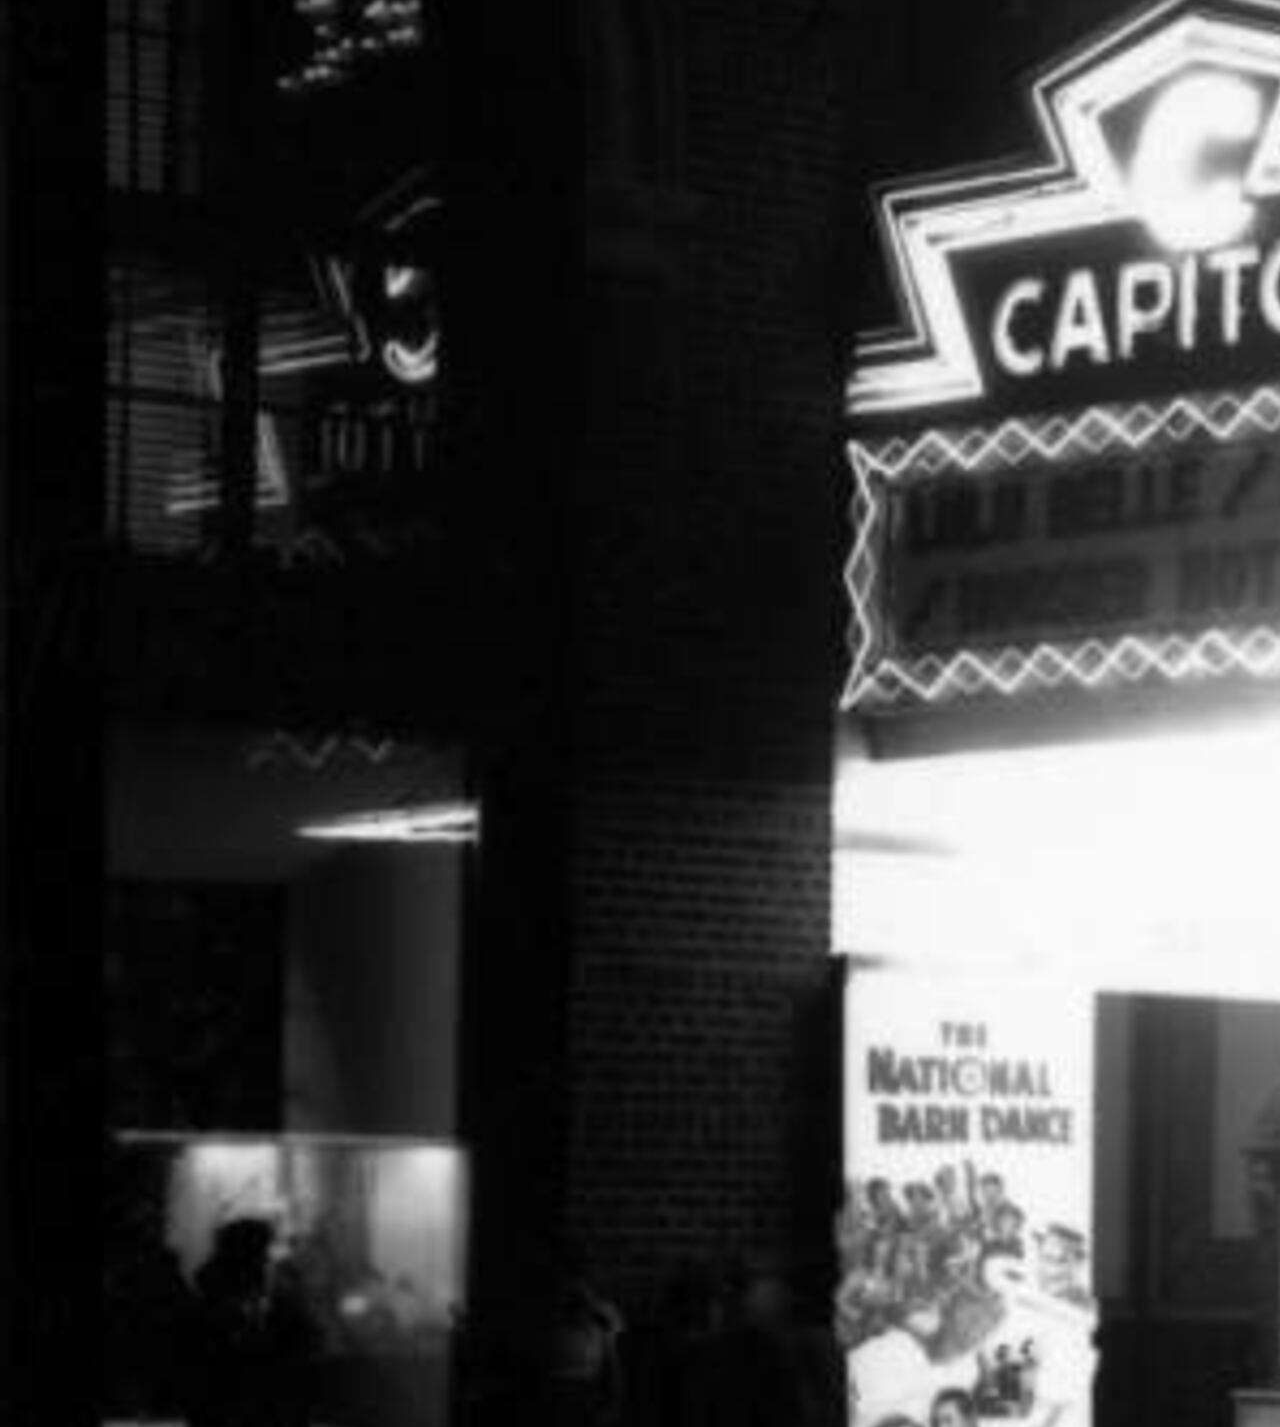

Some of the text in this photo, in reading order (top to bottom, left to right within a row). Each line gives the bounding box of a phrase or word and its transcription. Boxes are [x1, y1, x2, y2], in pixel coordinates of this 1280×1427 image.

[1130, 74, 1262, 251] C
[866, 1042, 1053, 1098] NATIONAL
[875, 1100, 1076, 1147] BARN DANCE
